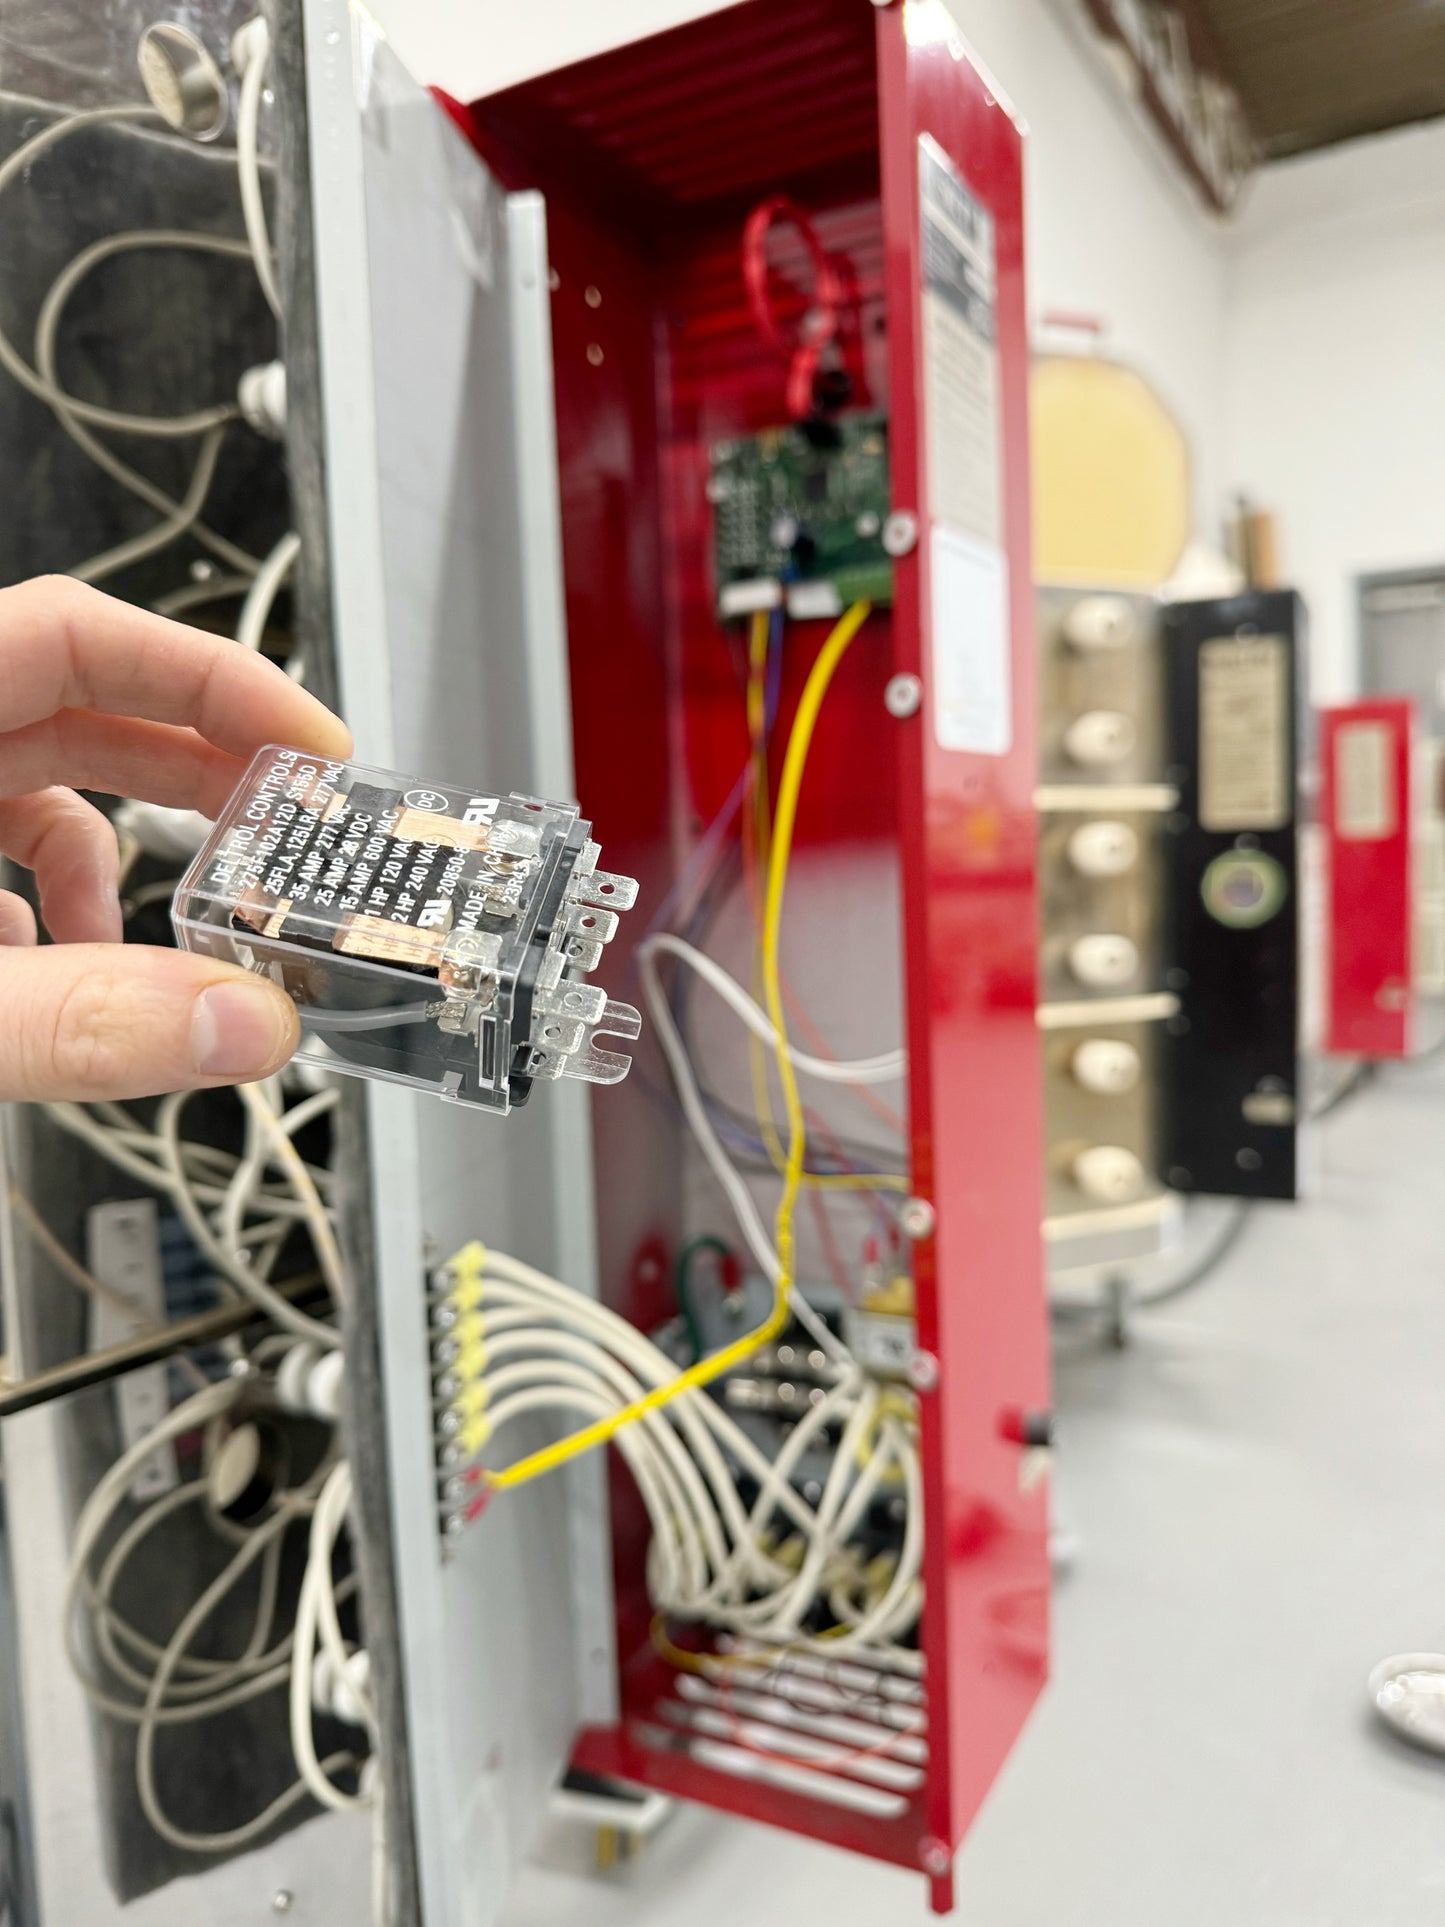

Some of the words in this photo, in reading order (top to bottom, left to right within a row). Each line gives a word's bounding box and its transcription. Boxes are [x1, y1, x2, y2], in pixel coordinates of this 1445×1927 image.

[417, 793, 436, 808] DC
[211, 825, 260, 884] DELTROL
[246, 751, 297, 821] CONTROLS
[328, 804, 351, 824] VAC
[345, 813, 373, 838] VDC
[374, 810, 399, 834] VAC
[286, 807, 323, 849] 125LRA
[315, 826, 340, 849] 277
[239, 803, 297, 889] 275F102A12D
[338, 840, 360, 857] 28
[363, 837, 388, 860] 600
[484, 823, 514, 865] CHINA
[298, 851, 325, 882] AMP
[323, 857, 350, 889] AMP
[347, 862, 374, 895] AMP
[405, 866, 429, 891] 240
[475, 870, 495, 886] IN
[289, 883, 311, 900] 35
[368, 886, 390, 907] HP
[380, 861, 403, 884] 120
[314, 889, 335, 906] 25
[339, 895, 359, 910] 15
[394, 892, 416, 913] HP
[391, 912, 409, 923] 2
[456, 890, 488, 932] MADE
